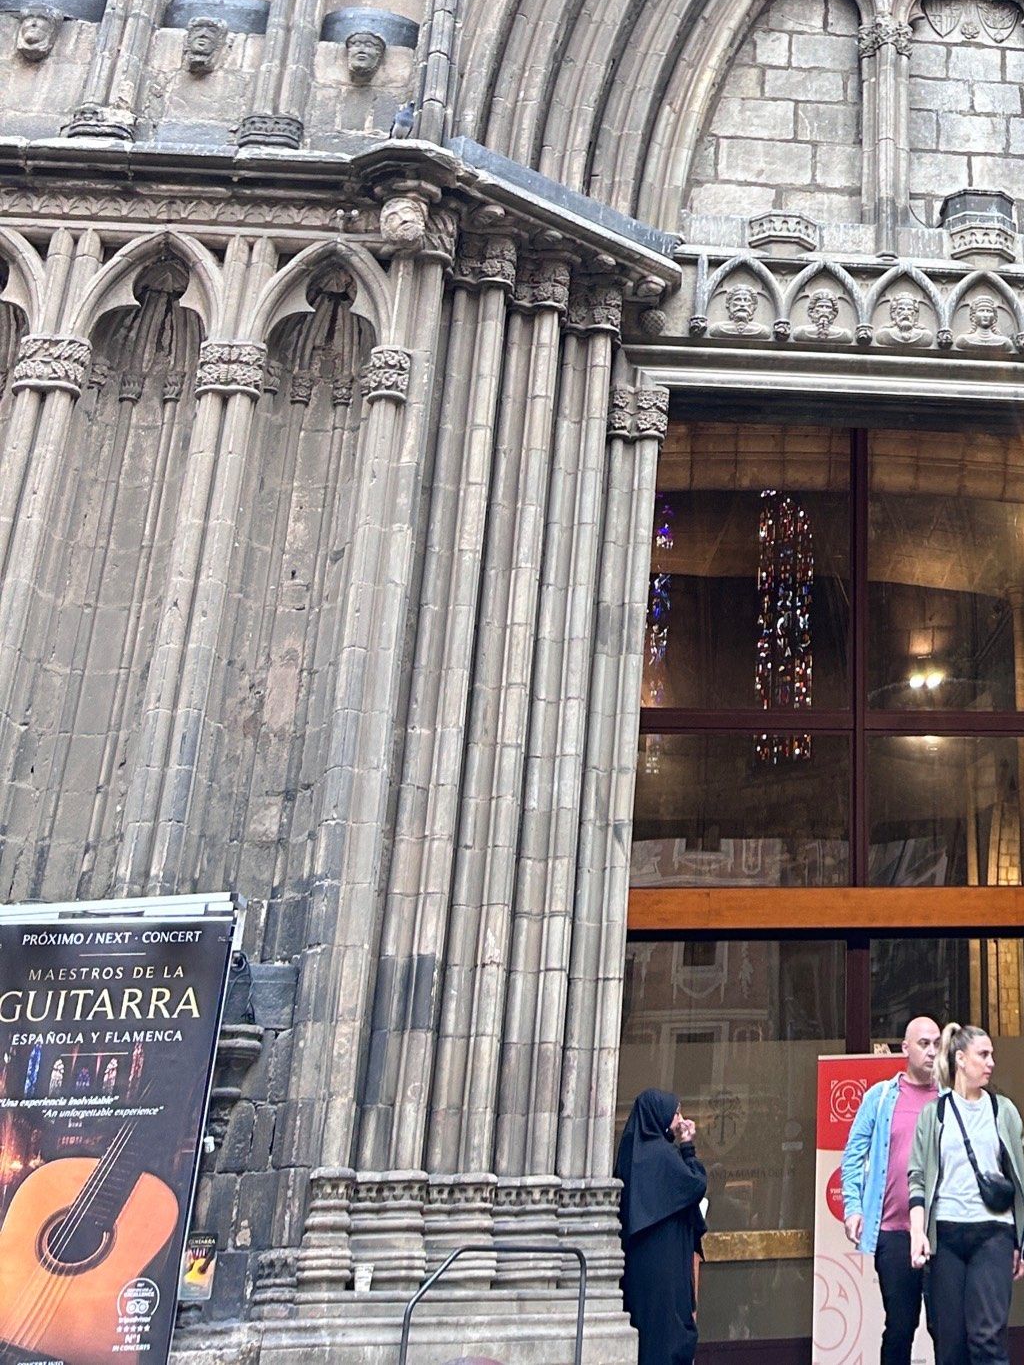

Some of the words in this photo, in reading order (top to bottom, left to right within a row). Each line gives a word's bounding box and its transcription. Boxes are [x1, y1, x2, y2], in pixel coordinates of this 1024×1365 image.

[22, 931, 84, 946] PRÓXIMO
[95, 931, 132, 945] NEXT
[142, 930, 202, 944] CONCERT
[28, 966, 124, 981] MAESTROS
[132, 966, 154, 979] DE
[163, 966, 184, 978] LA
[0, 986, 200, 1023] GUITARRA
[11, 1031, 84, 1046] ESPAÑOLA
[91, 1032, 100, 1043] Y
[105, 1030, 183, 1044] FLAMENCA
[19, 1097, 67, 1109] experiencia
[59, 1107, 114, 1120] unforgettable
